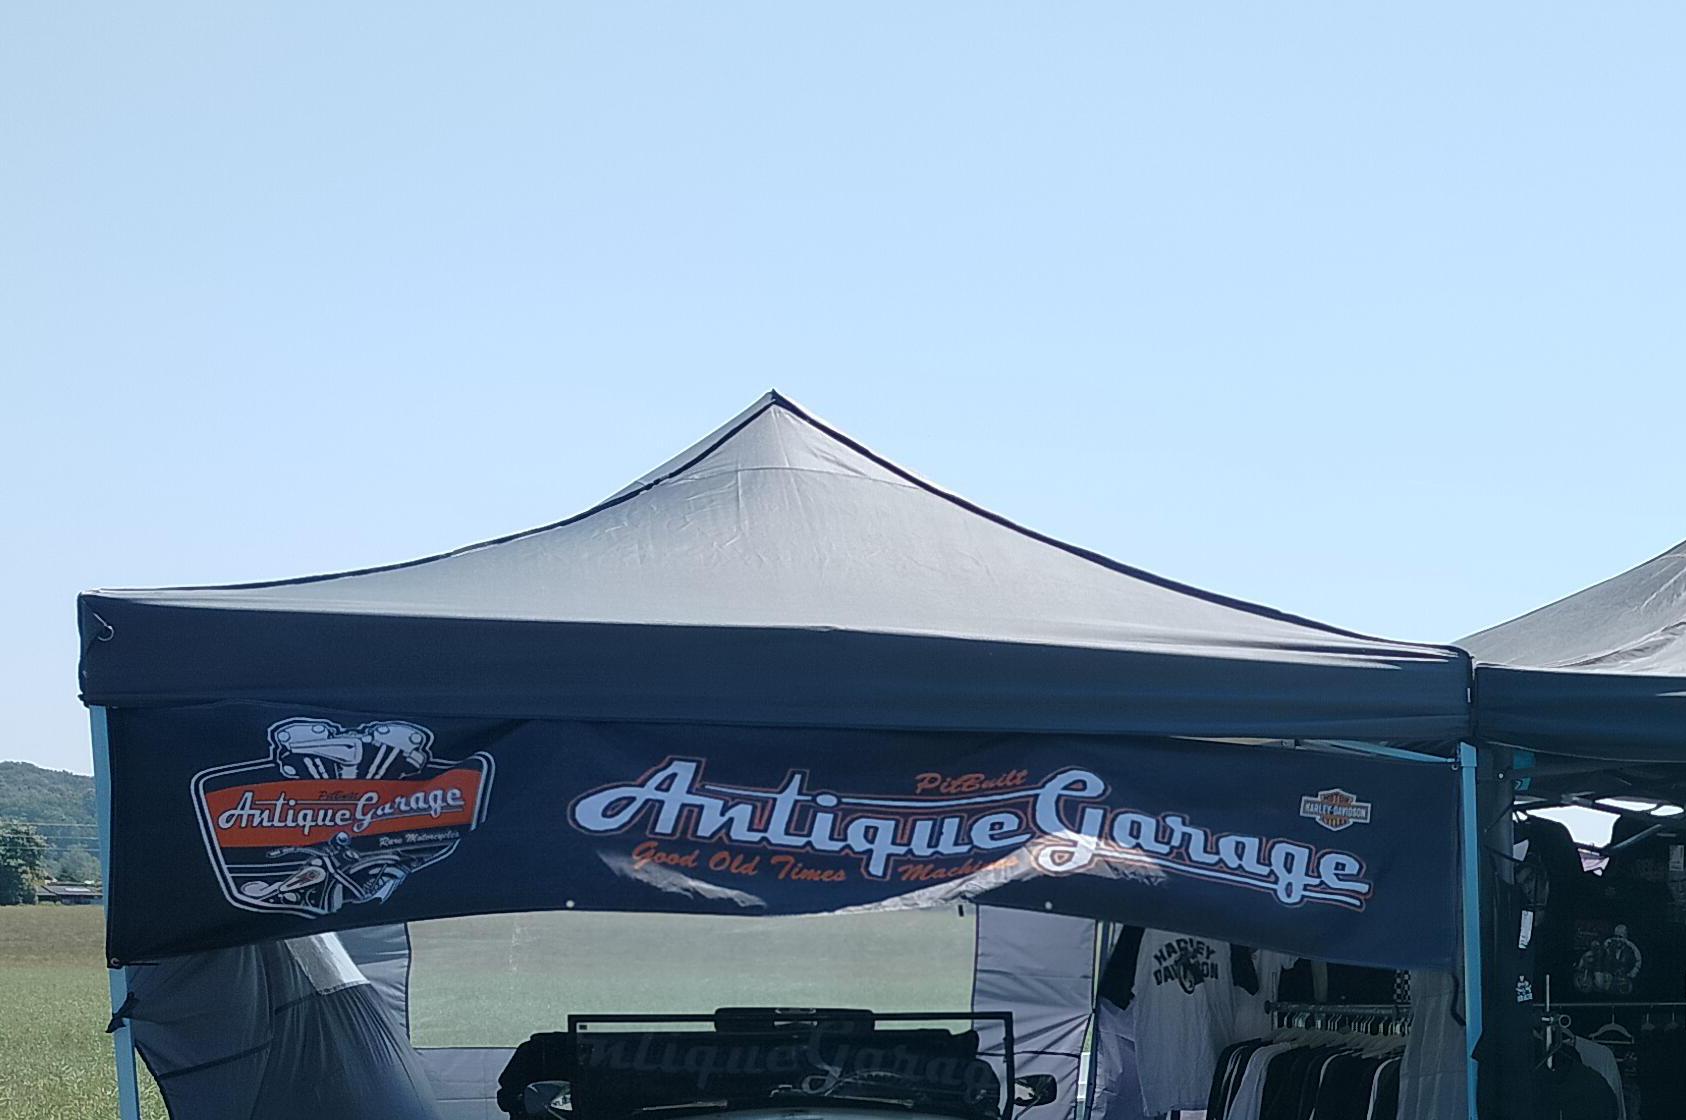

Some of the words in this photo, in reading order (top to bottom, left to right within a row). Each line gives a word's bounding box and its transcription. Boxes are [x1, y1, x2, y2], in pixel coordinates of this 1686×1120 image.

[916, 769, 1029, 793] PitBuilt
[631, 841, 698, 870] Good
[709, 851, 759, 876] Old
[770, 855, 847, 882] Times
